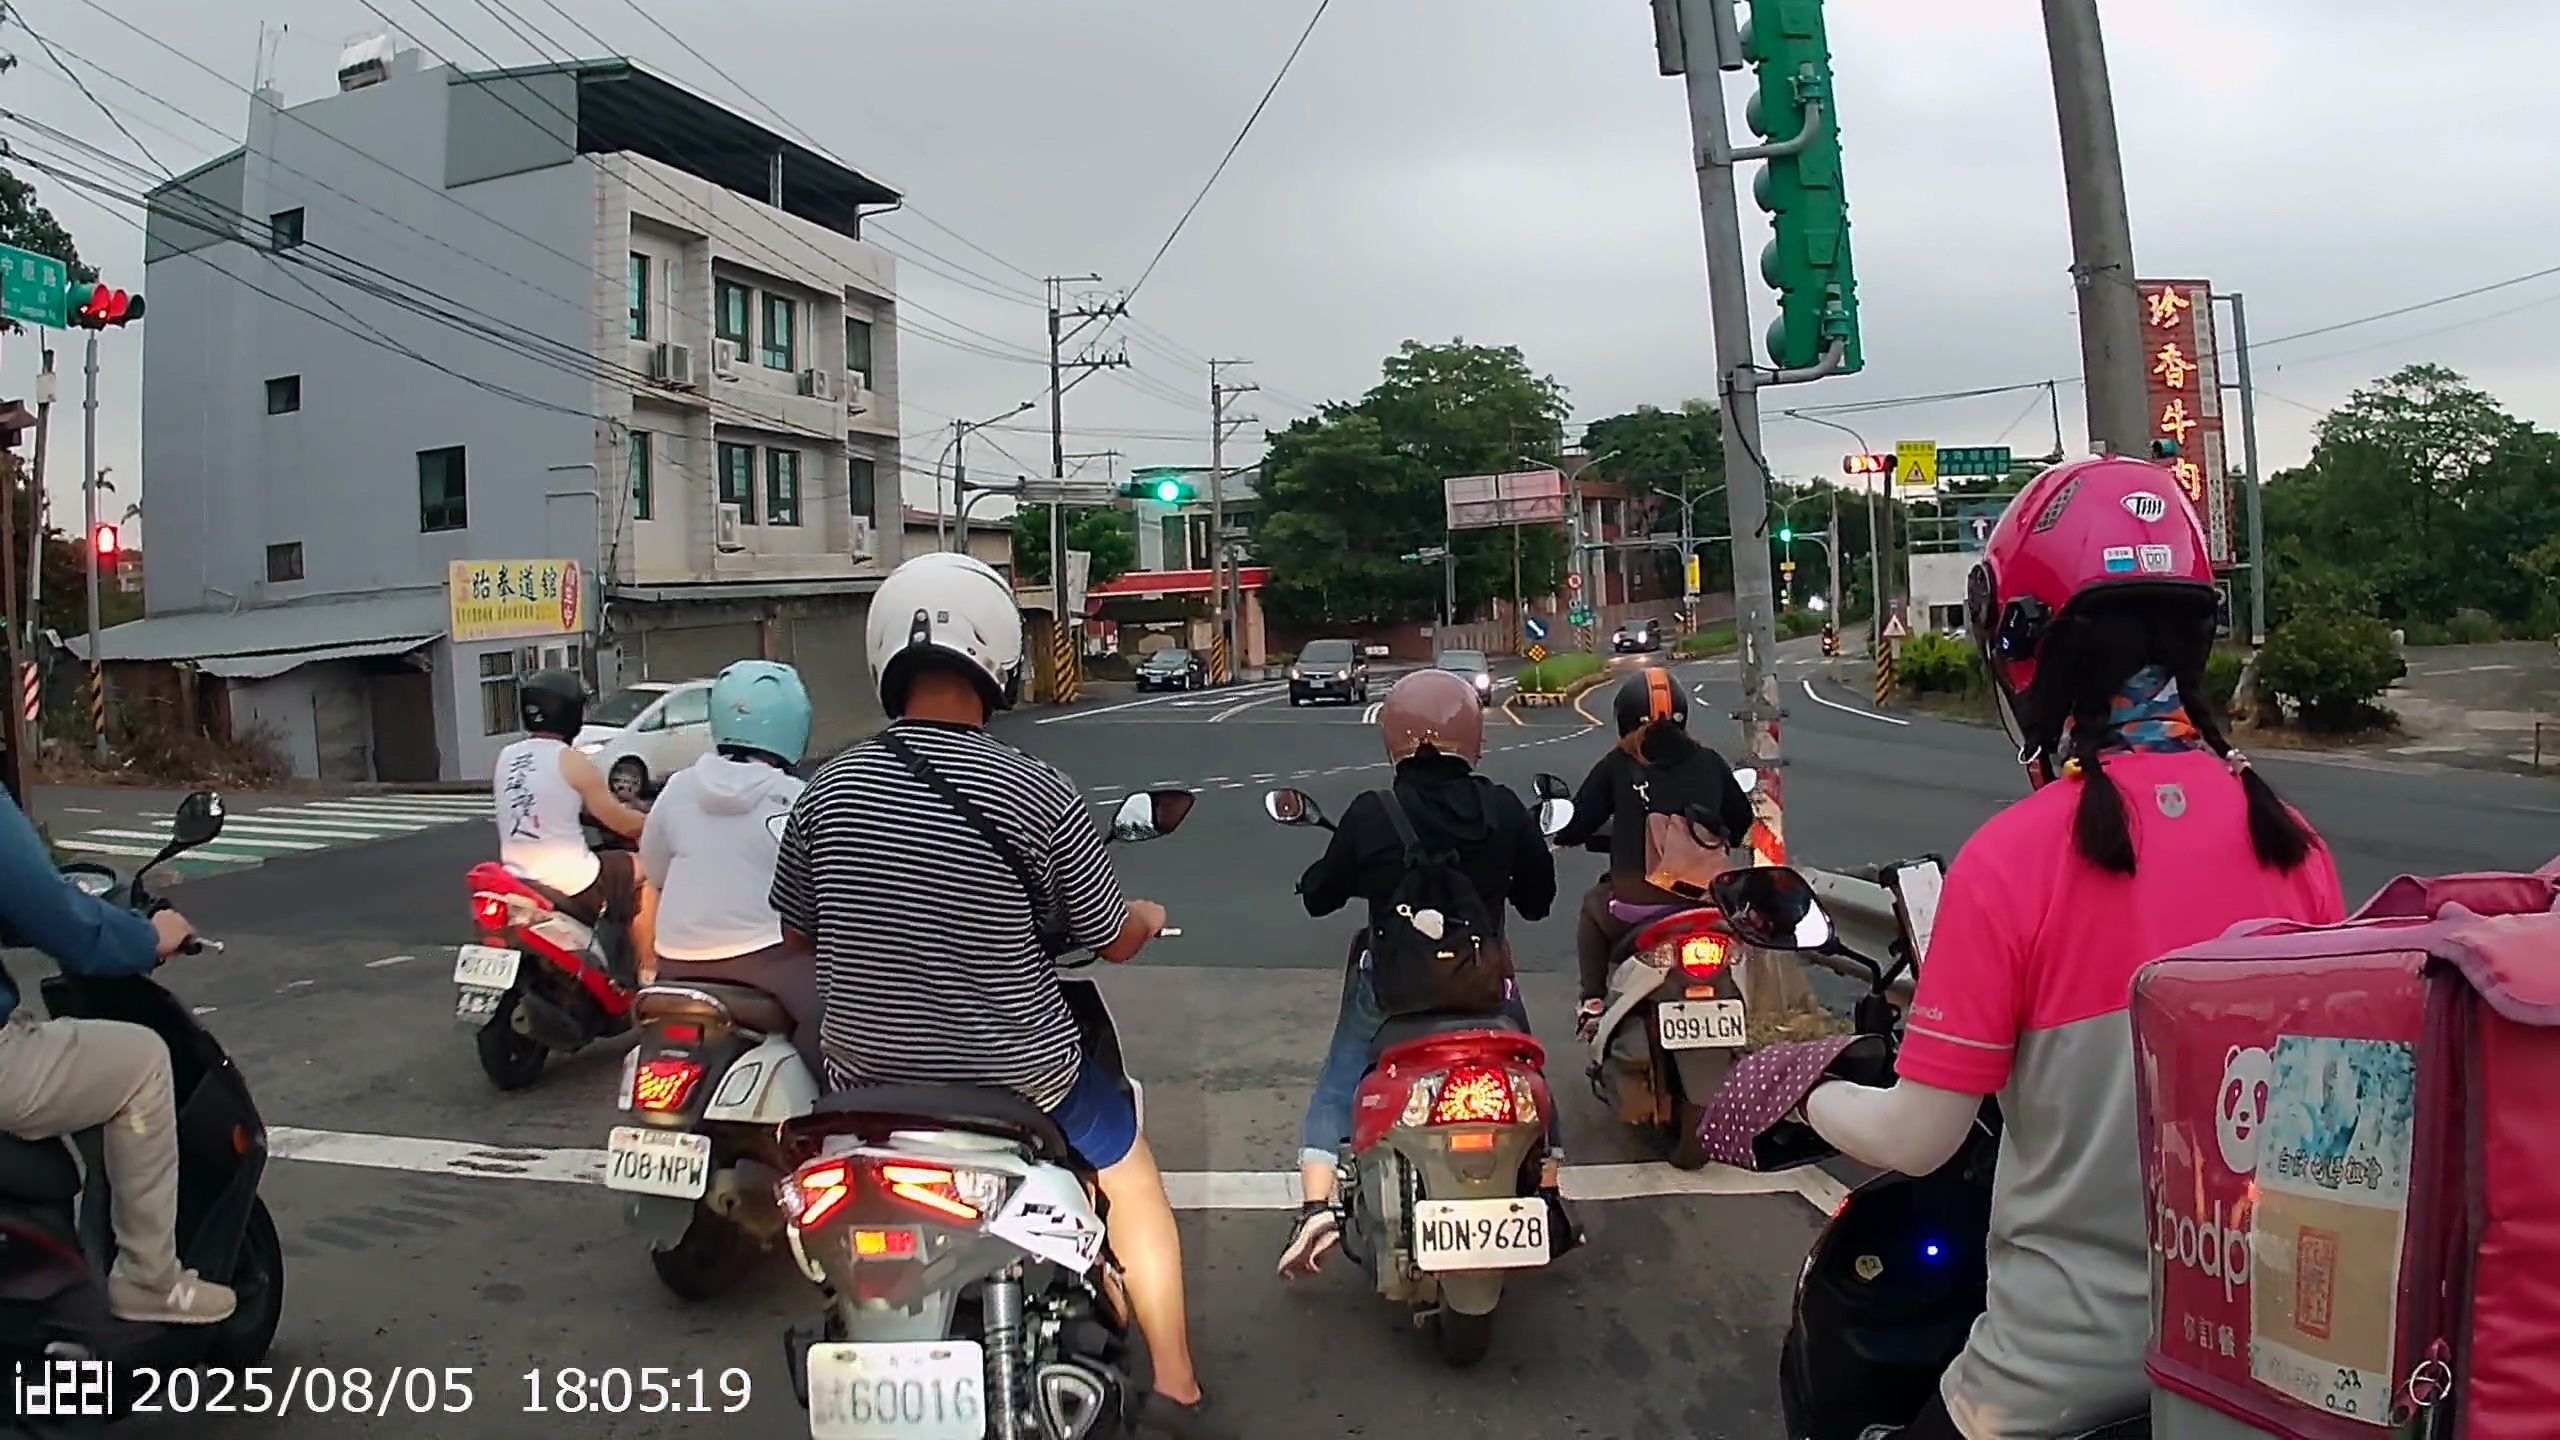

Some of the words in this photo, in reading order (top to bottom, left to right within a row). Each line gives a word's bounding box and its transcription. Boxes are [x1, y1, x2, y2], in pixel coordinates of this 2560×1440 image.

[1663, 1016, 1742, 1040] 099-LGN
[611, 1148, 704, 1186] 708-NPW
[1422, 1216, 1543, 1252] MDN-9628
[2153, 1194, 2251, 1303] foodp
[814, 1377, 978, 1426] 60016
